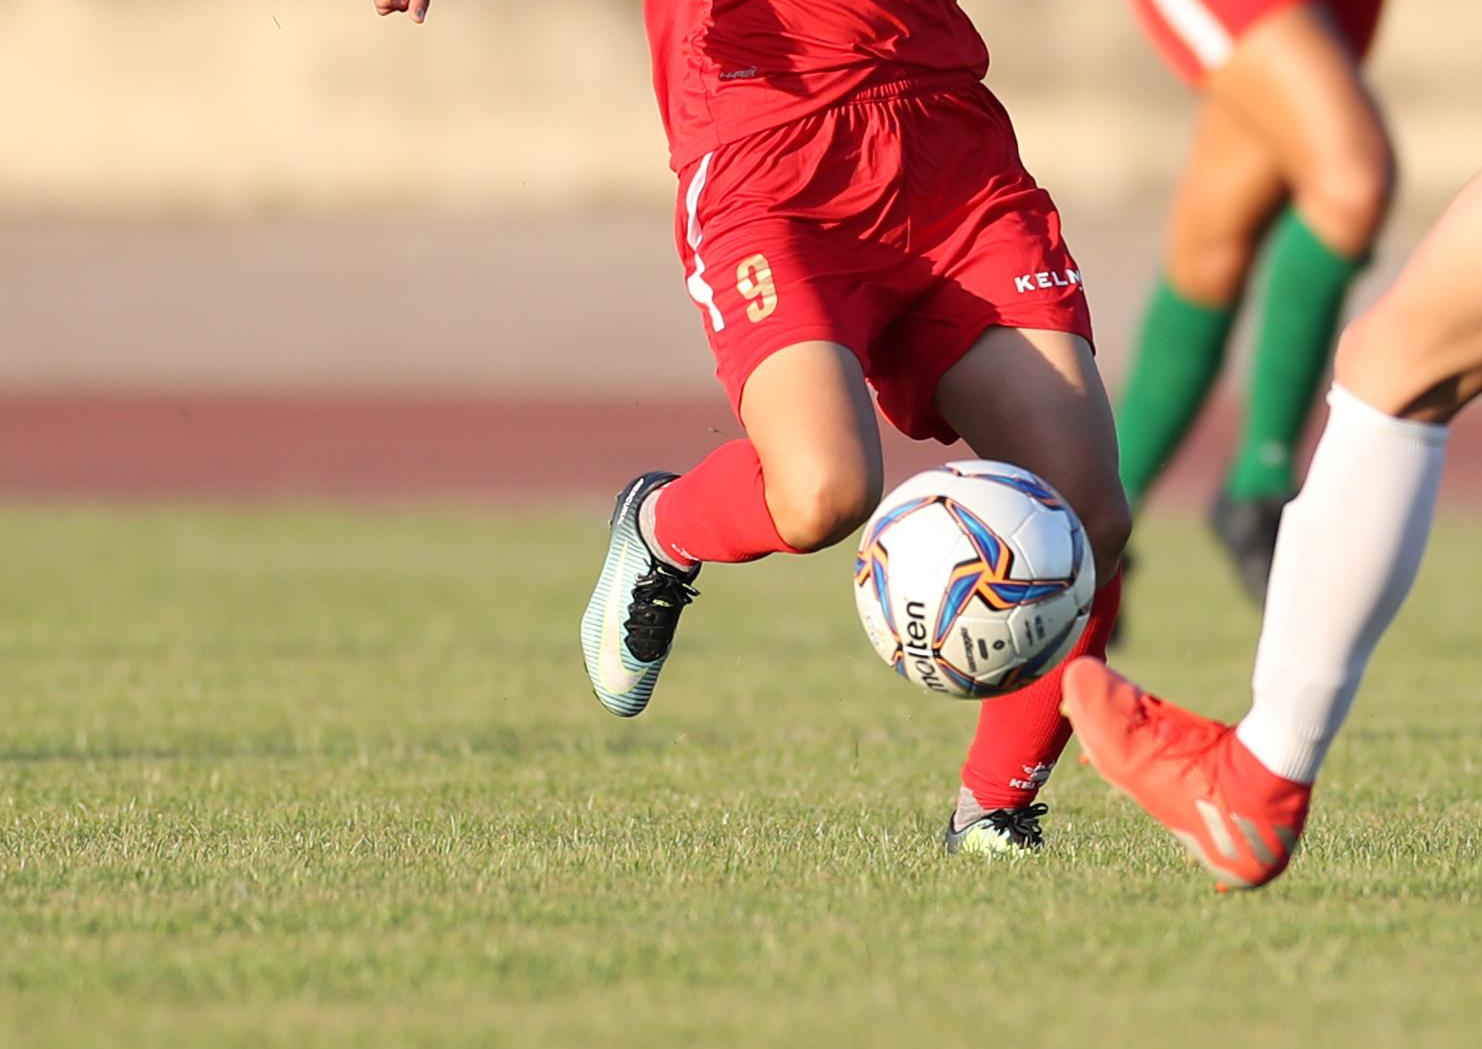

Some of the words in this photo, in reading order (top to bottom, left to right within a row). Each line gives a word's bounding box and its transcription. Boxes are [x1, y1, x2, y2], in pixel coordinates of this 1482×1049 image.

[736, 253, 778, 323] 9
[1014, 268, 1082, 294] KELM
[906, 601, 950, 693] molten
